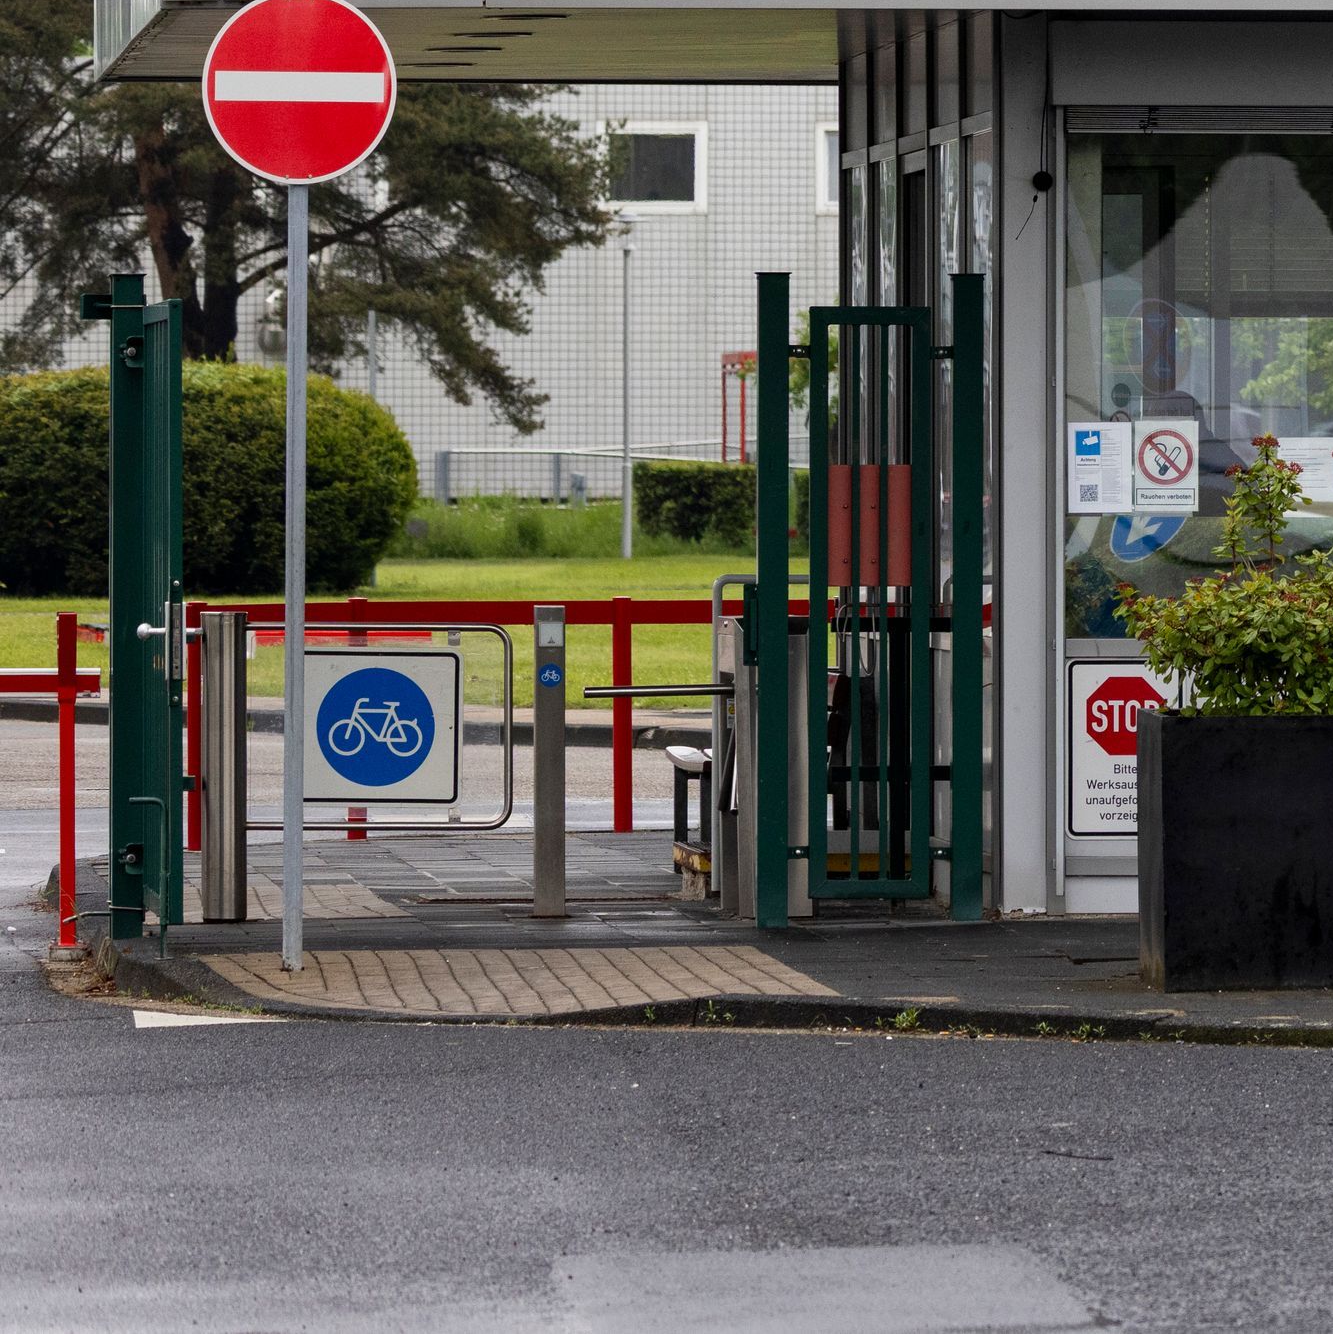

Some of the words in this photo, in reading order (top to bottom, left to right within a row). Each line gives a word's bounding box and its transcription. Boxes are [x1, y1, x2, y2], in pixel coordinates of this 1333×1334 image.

[1091, 699, 1160, 733] STO
[1113, 763, 1138, 774] Bitte
[1086, 779, 1138, 790] Werksaus
[1085, 794, 1138, 807] unaufgefo
[1099, 810, 1138, 823] vorzeig
